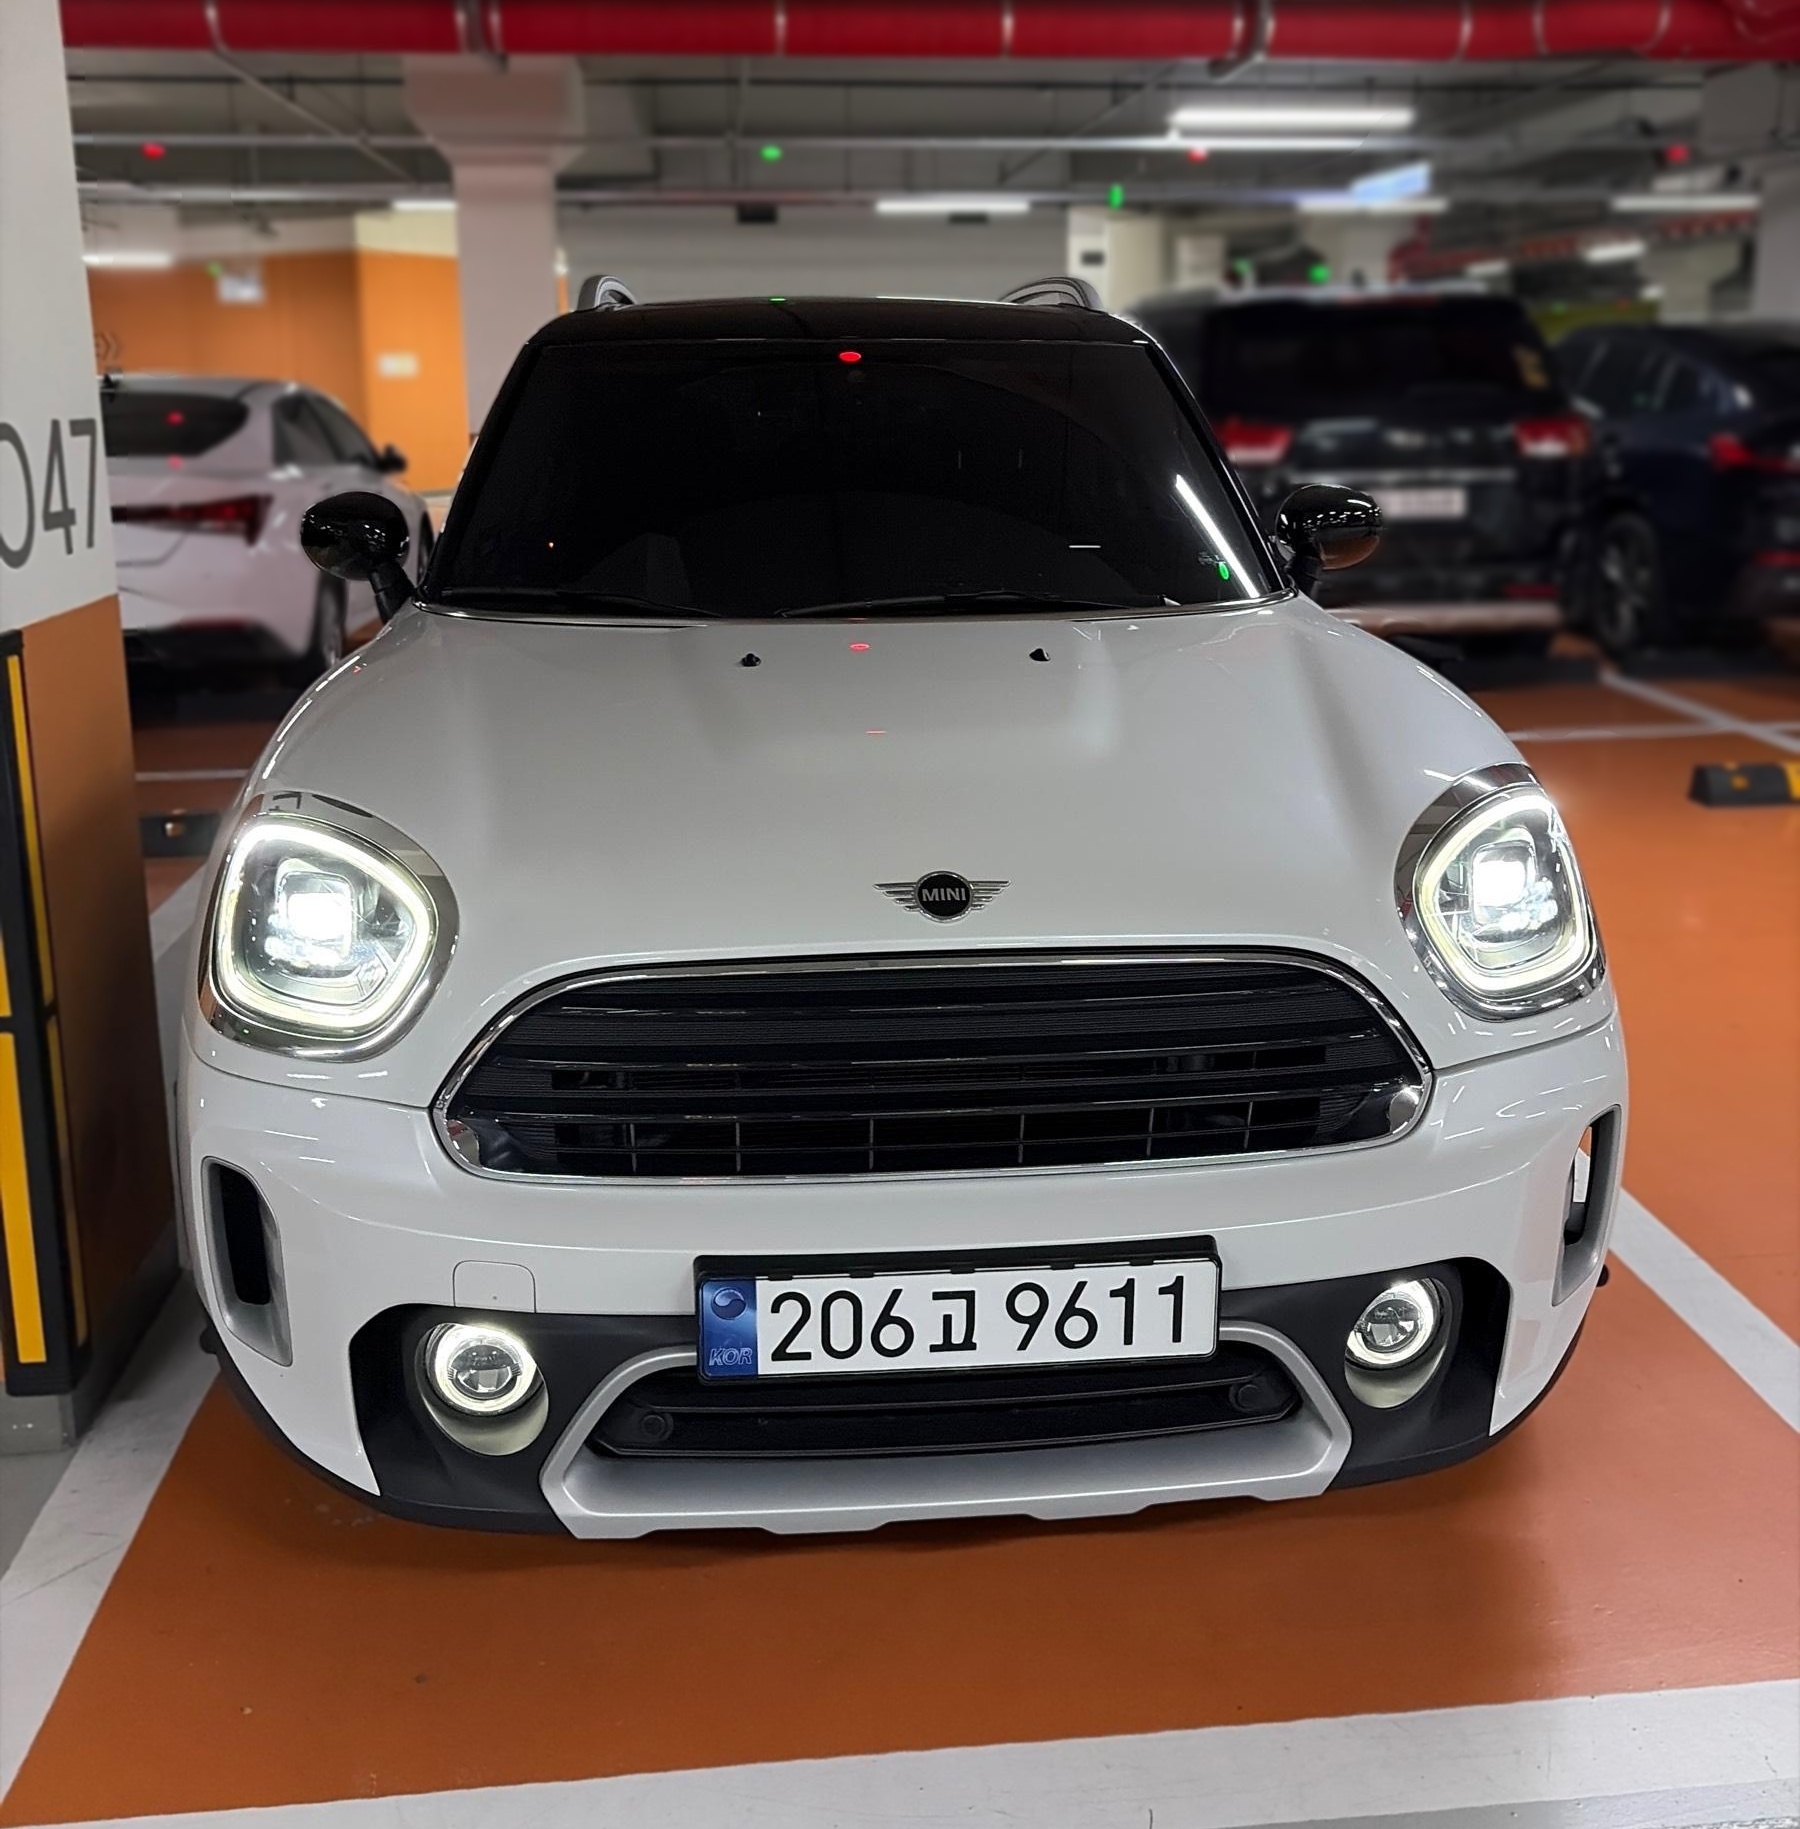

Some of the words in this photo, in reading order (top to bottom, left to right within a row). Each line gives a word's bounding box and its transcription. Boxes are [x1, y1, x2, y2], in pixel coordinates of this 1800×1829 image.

[922, 887, 967, 902] MINI
[770, 1288, 977, 1362] 206고
[1005, 1275, 1185, 1351] 9611
[708, 1347, 752, 1366] KOR
